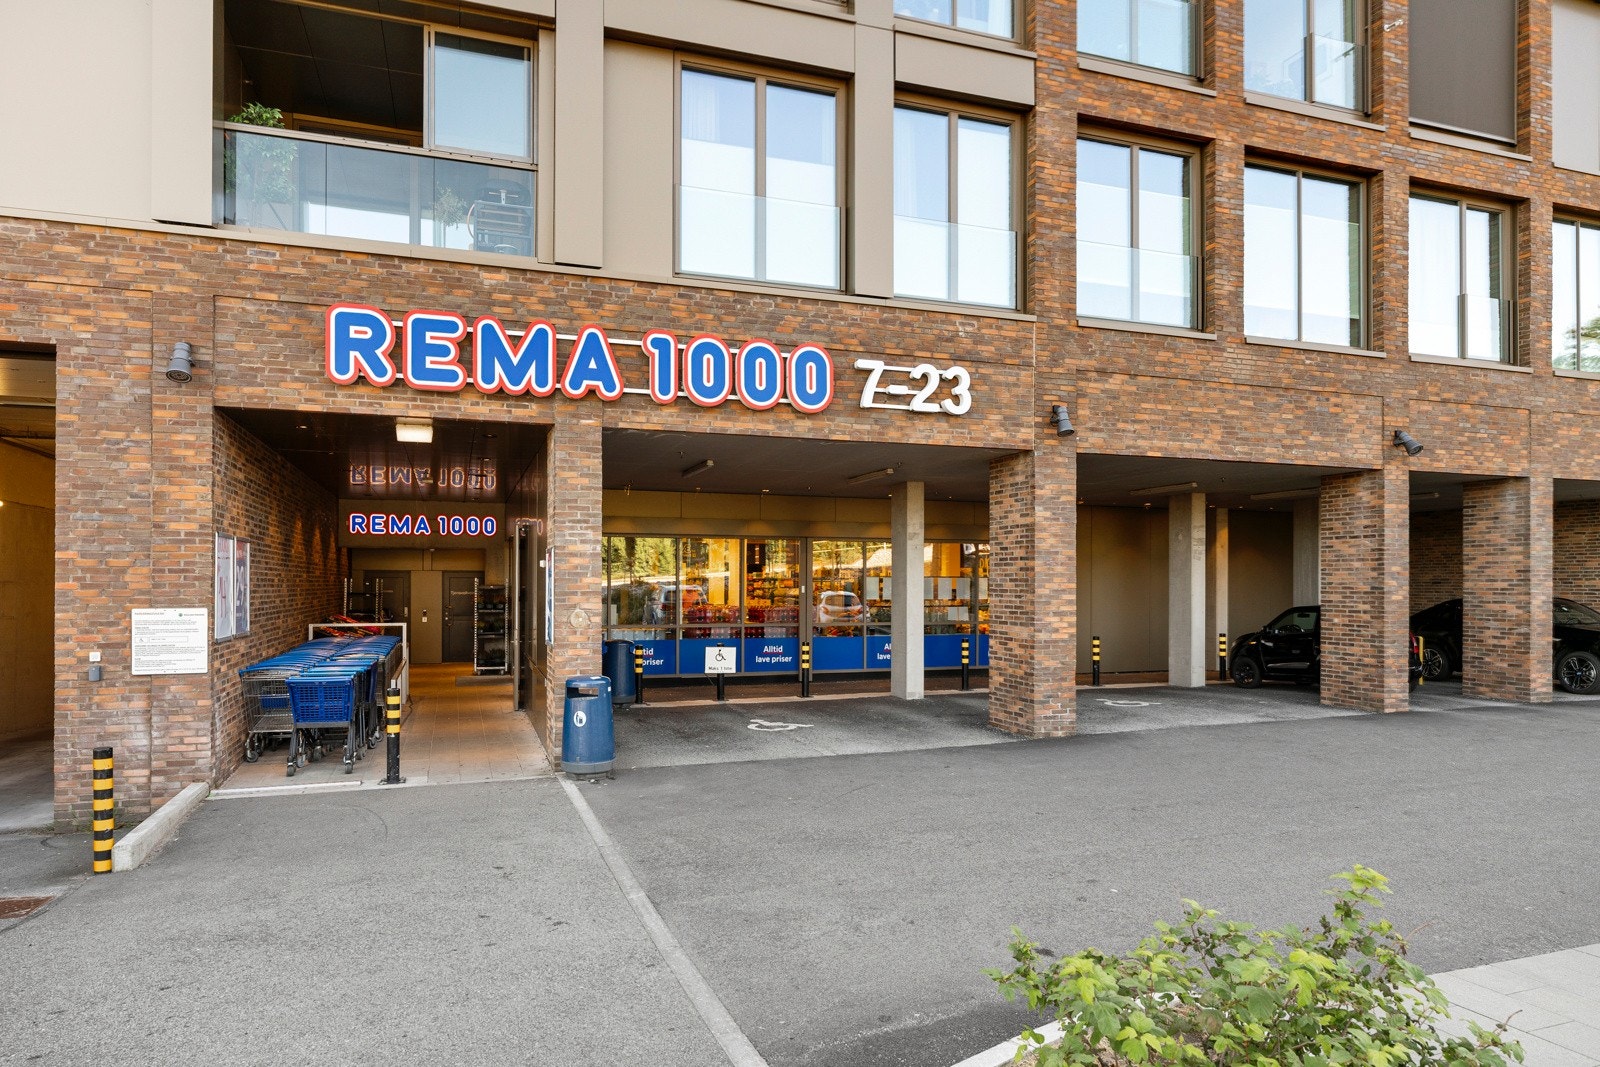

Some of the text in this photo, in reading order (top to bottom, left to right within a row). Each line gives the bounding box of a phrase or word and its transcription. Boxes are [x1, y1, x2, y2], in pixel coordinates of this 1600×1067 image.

[325, 303, 833, 413] REMA 1000
[853, 358, 972, 415] 7-23
[348, 513, 431, 536] REMA
[437, 515, 498, 537] 1000
[755, 654, 792, 664] lave priser
[763, 645, 783, 653] Alltid
